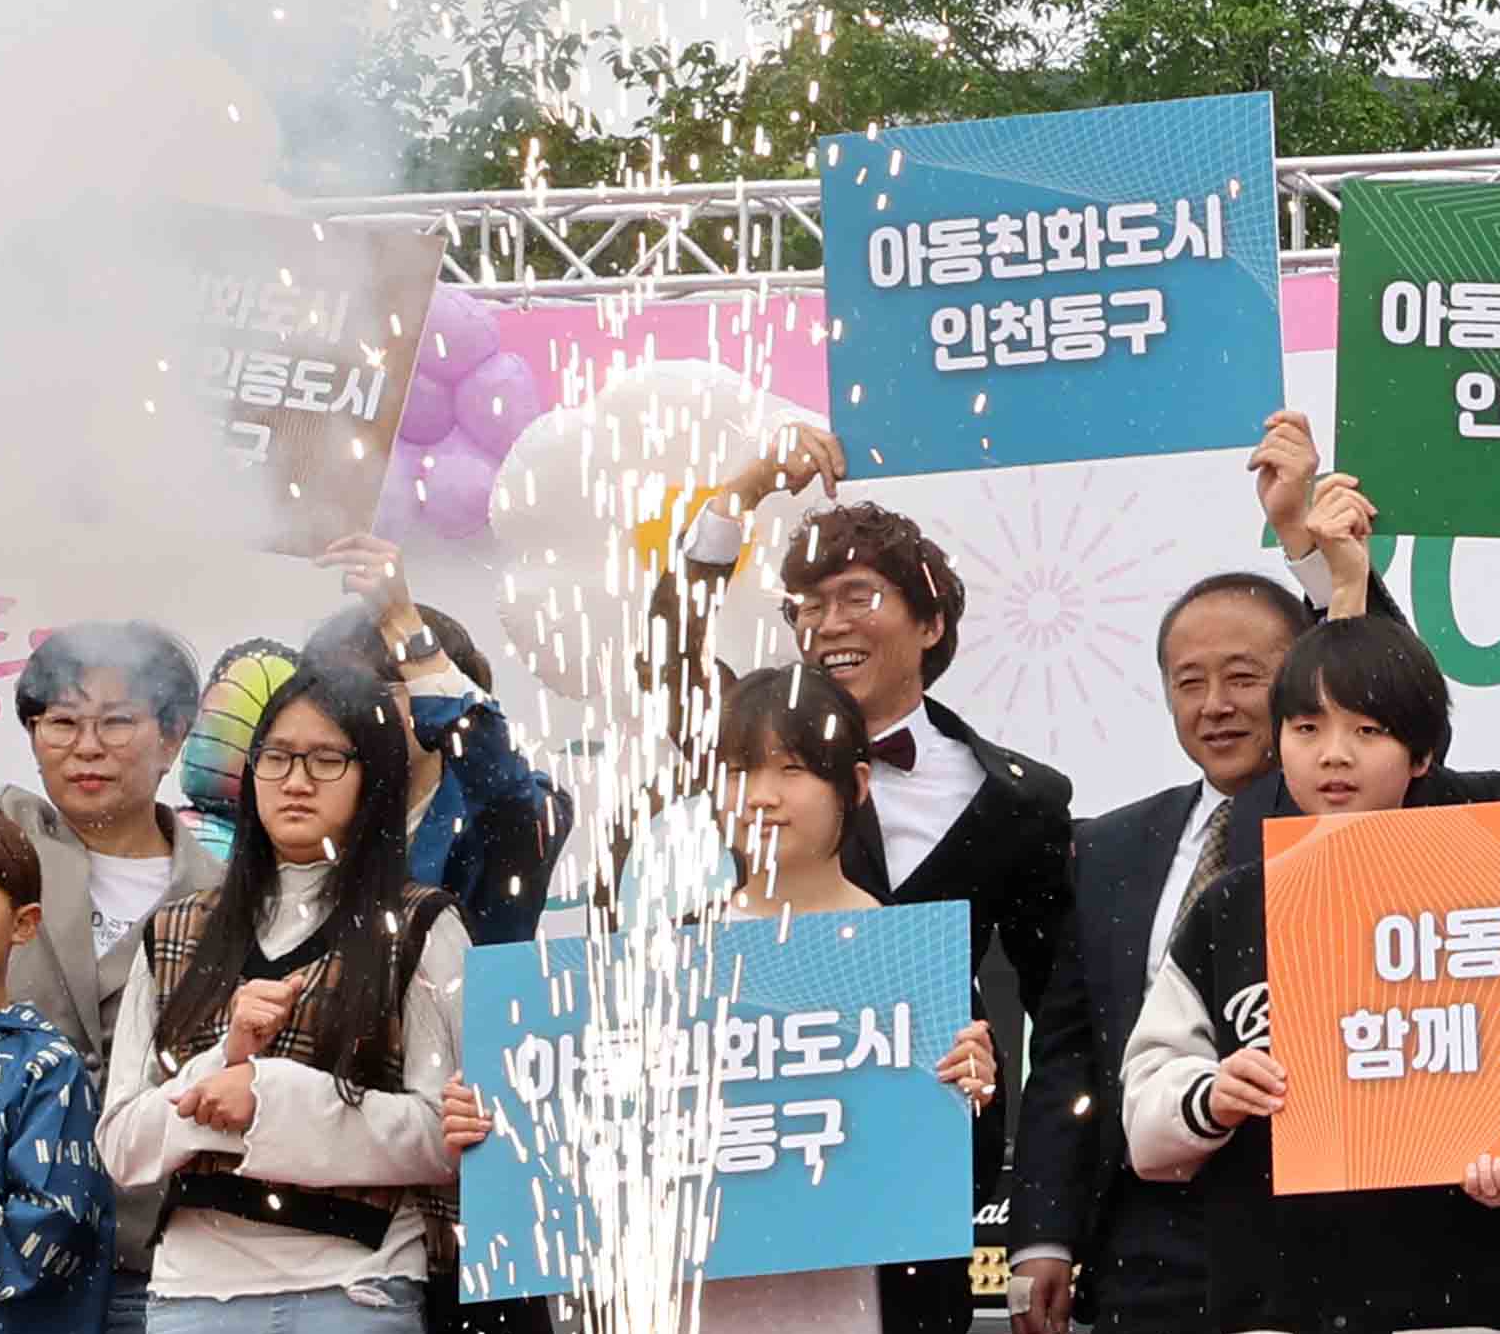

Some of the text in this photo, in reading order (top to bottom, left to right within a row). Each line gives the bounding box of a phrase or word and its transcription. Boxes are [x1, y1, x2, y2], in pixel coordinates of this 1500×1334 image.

[868, 194, 1224, 288] 아동친화도시
[931, 289, 1167, 371] 인천동구
[514, 1003, 911, 1103] 아화도시
[1340, 1002, 1479, 1082] 함께
[582, 1099, 845, 1181] 동구
